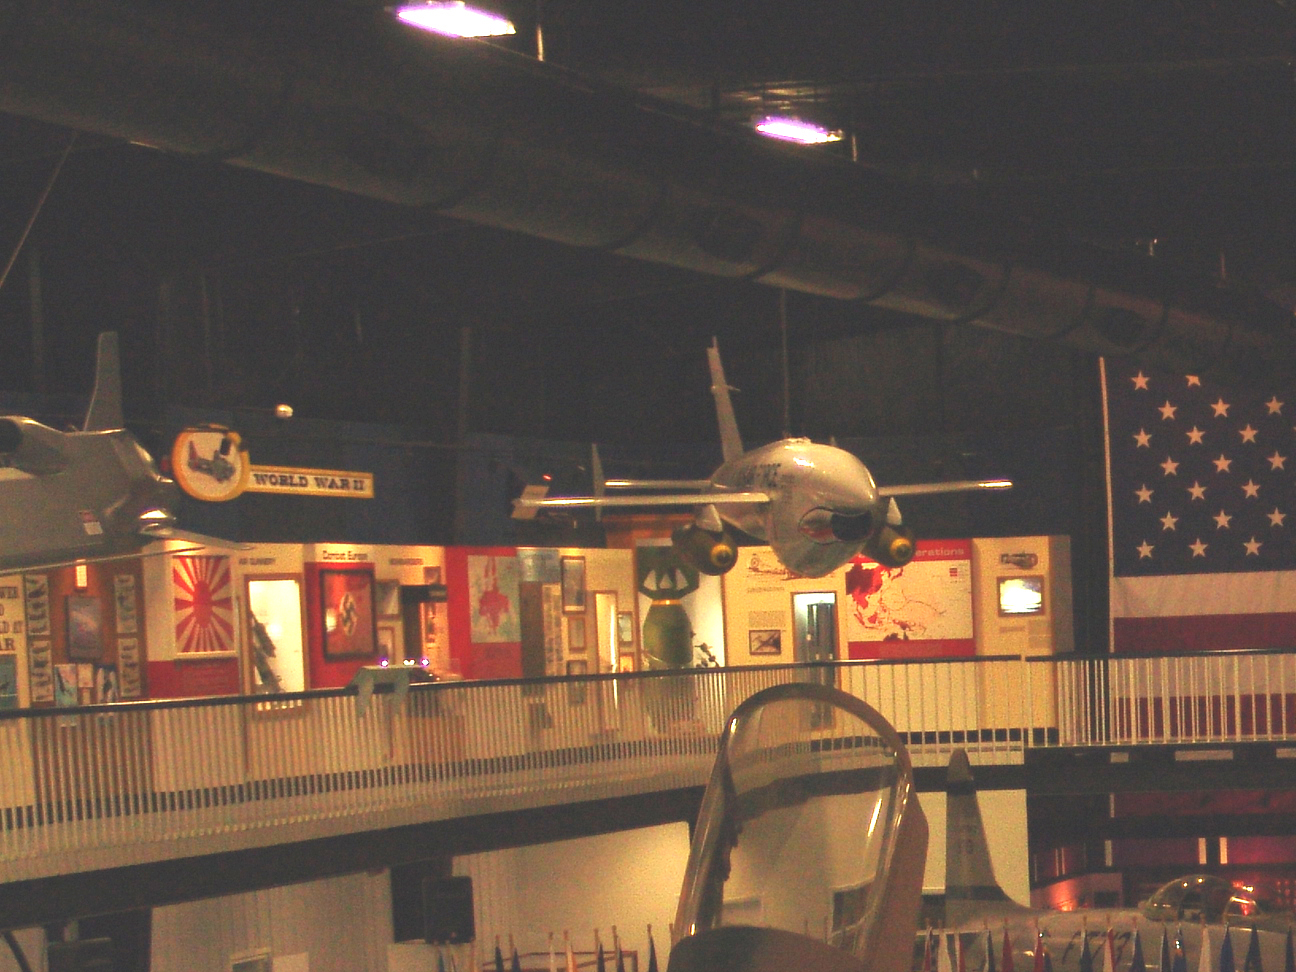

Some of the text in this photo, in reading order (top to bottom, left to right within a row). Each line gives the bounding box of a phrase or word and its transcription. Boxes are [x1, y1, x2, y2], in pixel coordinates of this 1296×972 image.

[254, 473, 365, 491] WORLD WAR II
